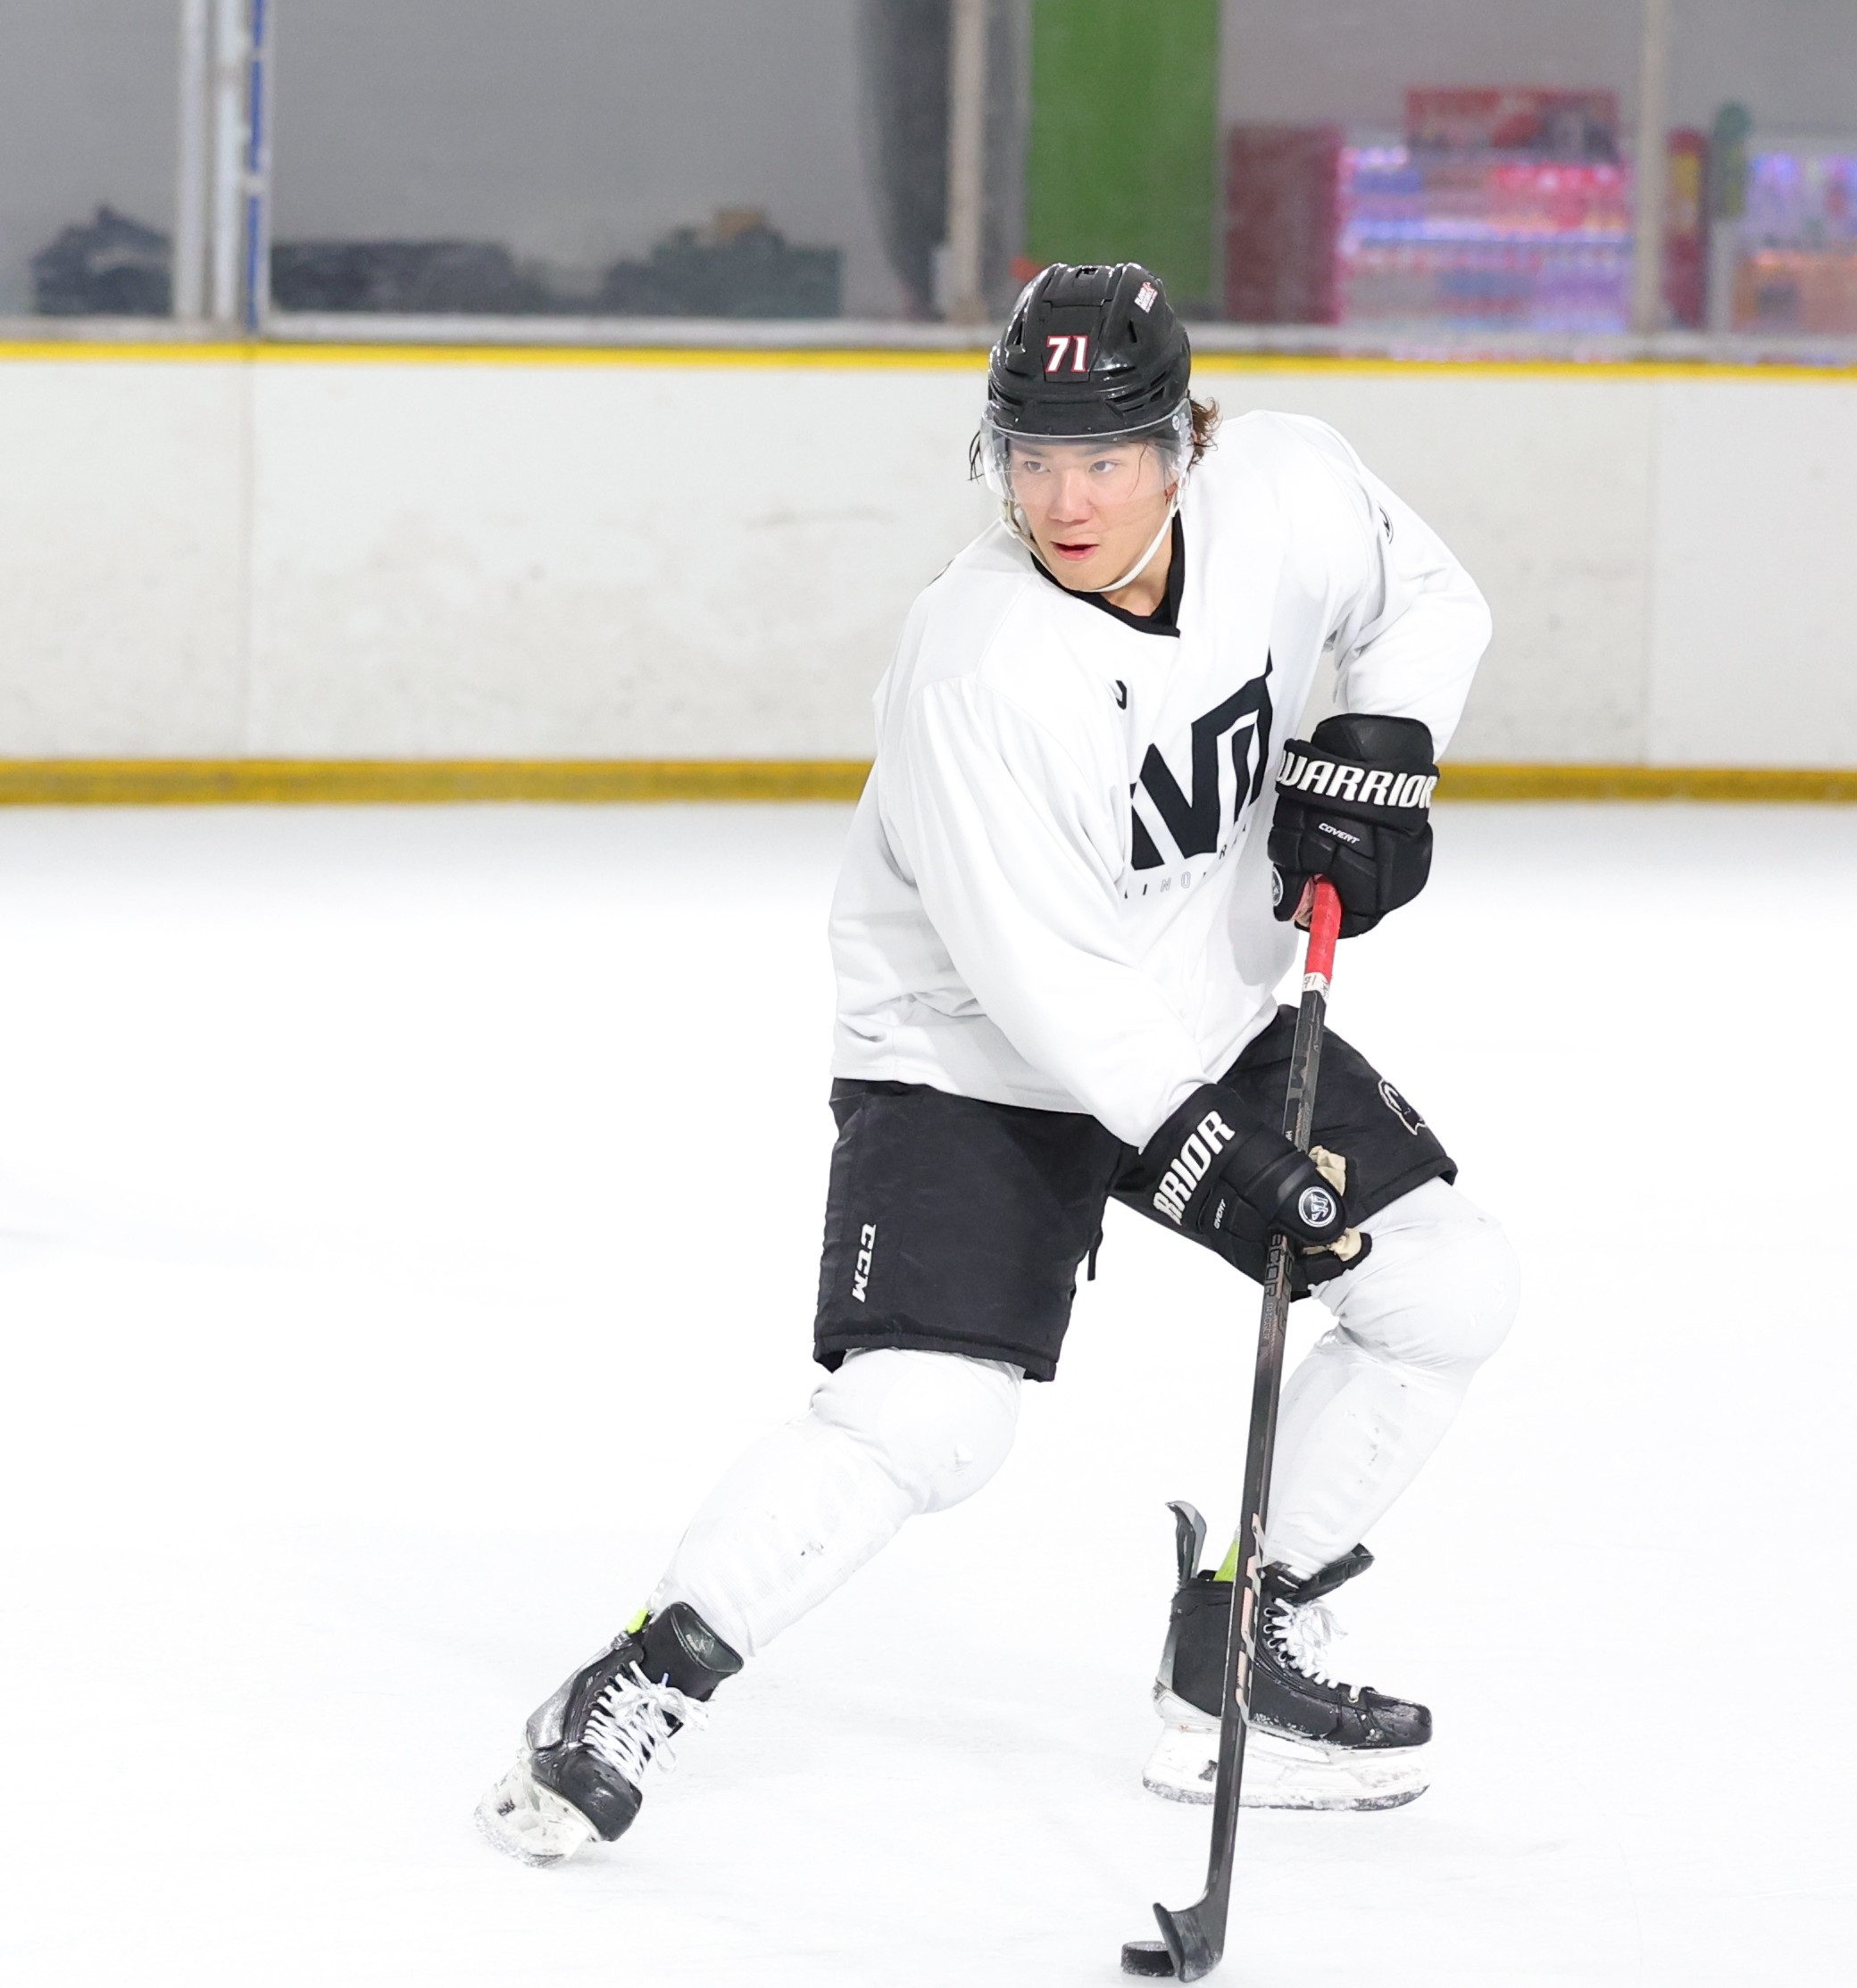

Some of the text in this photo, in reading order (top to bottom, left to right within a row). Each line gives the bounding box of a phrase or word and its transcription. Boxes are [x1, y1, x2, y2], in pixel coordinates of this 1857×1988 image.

[1045, 335, 1088, 373] 71
[1275, 749, 1438, 809] WARRIOR
[1318, 822, 1361, 844] COVERT
[852, 1223, 877, 1303] CCM
